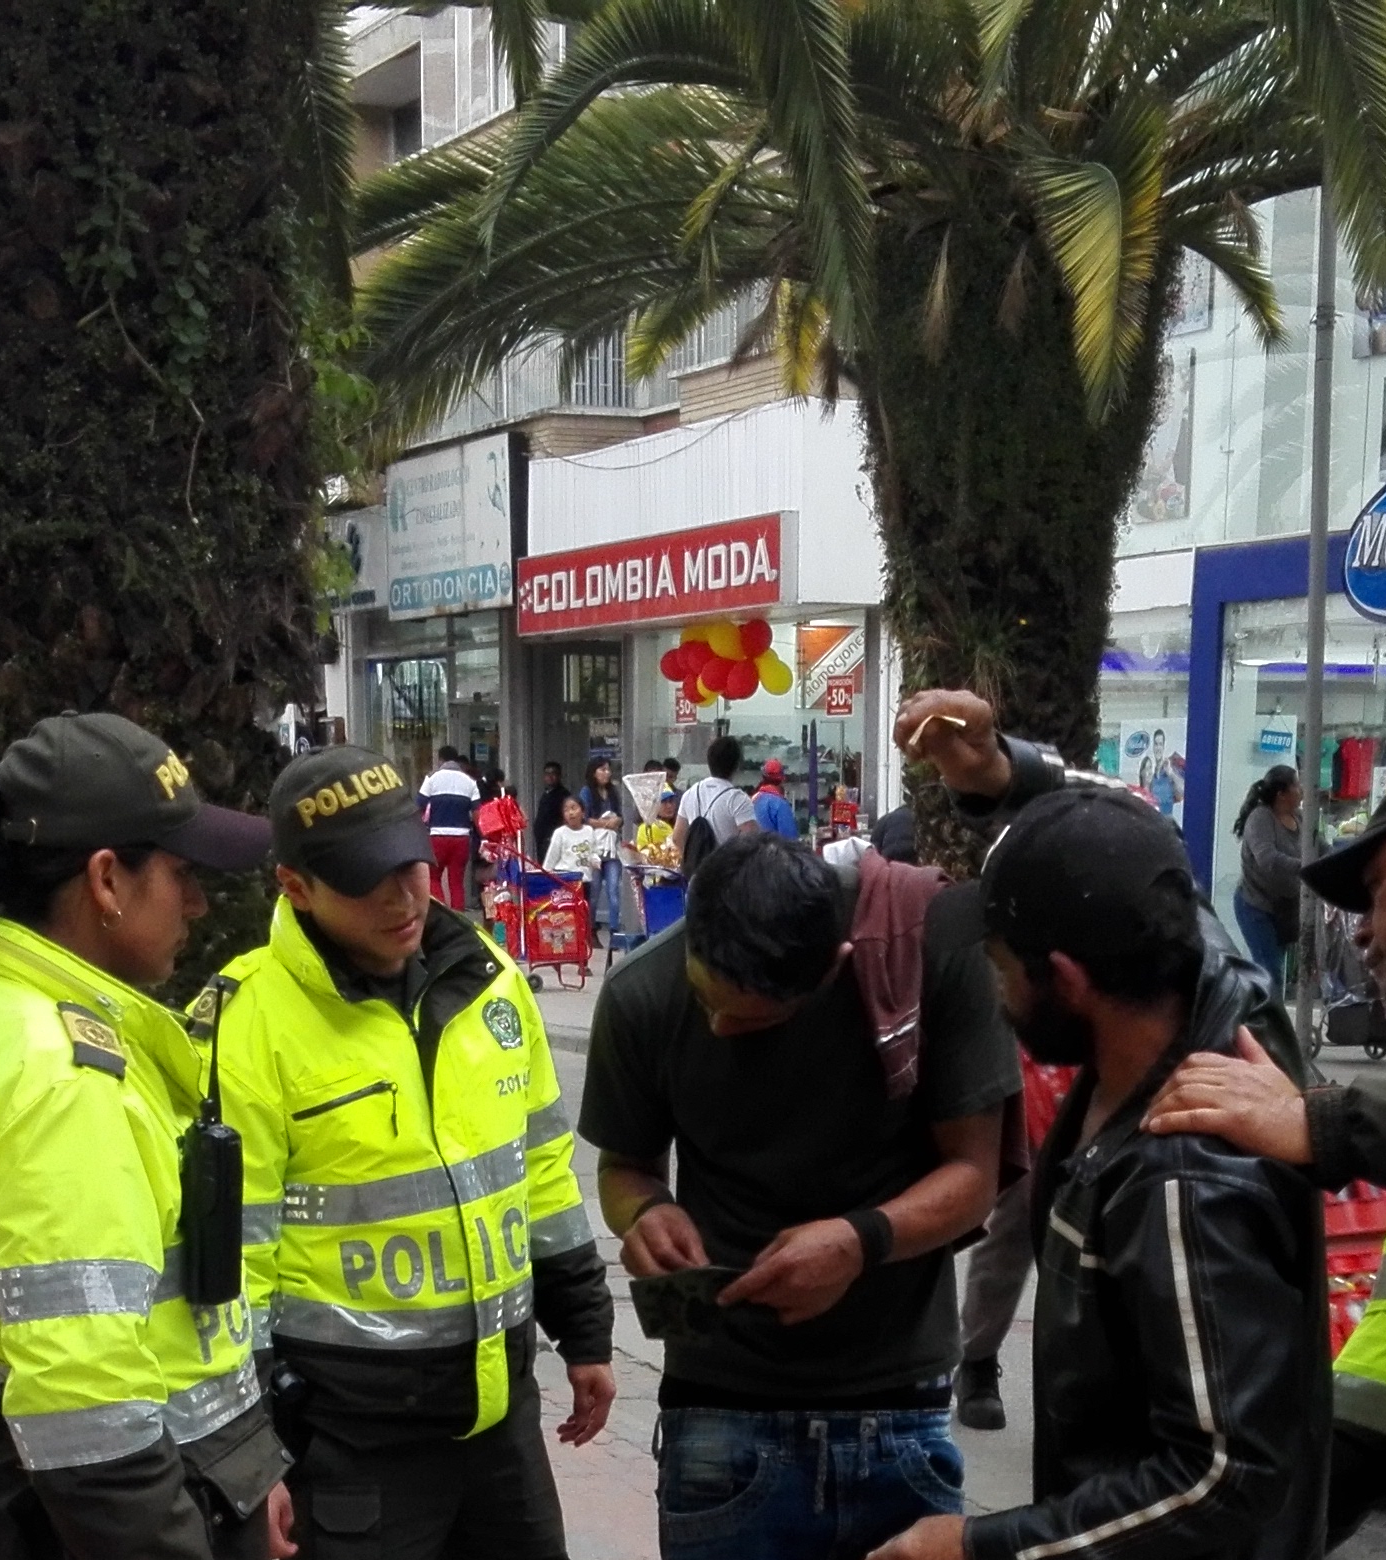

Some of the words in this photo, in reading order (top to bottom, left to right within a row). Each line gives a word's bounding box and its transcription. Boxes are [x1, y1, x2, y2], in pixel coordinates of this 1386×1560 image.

[392, 570, 496, 606] ORTODONCIA
[533, 553, 678, 614] COLOMBIA
[684, 536, 773, 594] MODA
[827, 688, 852, 706] -50%
[1262, 732, 1292, 749] ABIERTO
[296, 764, 404, 828] POLICIA
